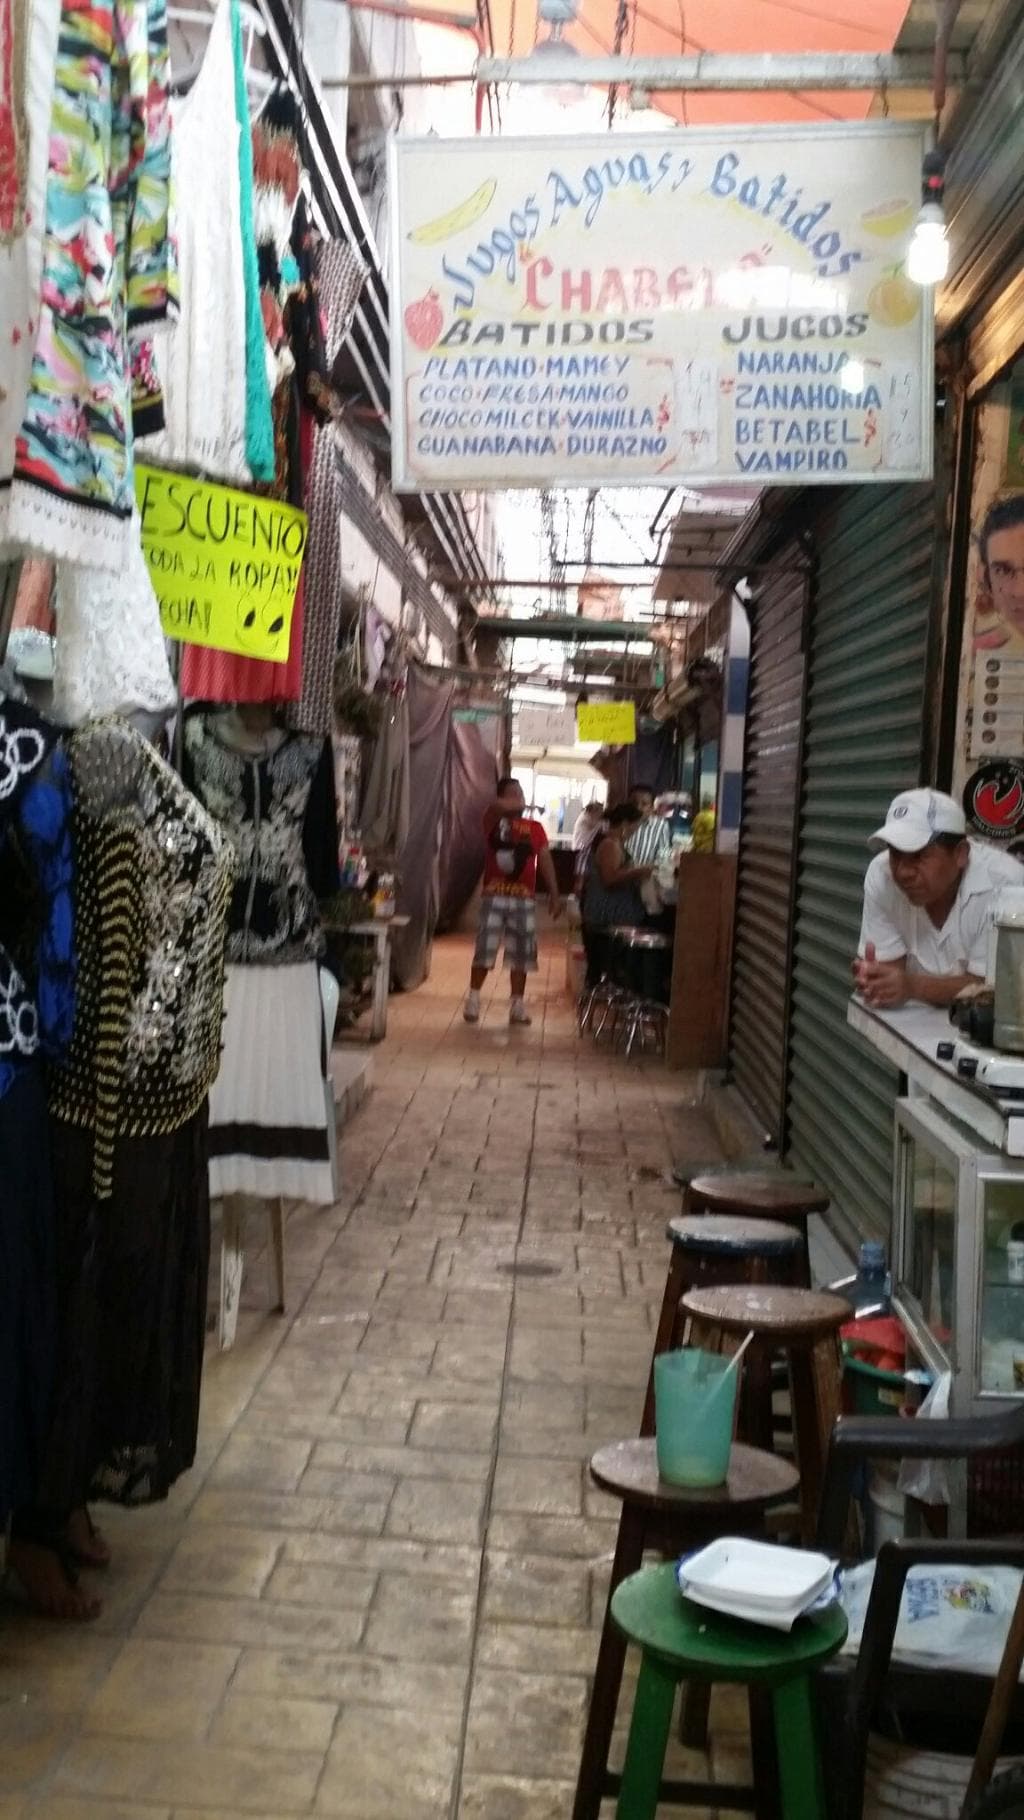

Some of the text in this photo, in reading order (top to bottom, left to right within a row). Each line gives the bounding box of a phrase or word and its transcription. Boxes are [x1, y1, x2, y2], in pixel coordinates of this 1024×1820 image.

[710, 153, 862, 277] Batidos
[438, 318, 654, 347] BATIDOS
[423, 354, 630, 380] PLATANO MAMEY
[419, 382, 630, 404] COCO FRESA MANGO
[566, 407, 654, 430] VAINILLA
[735, 418, 861, 445] BETABEL
[417, 433, 667, 457] GUANABANA DURAZNO
[734, 449, 849, 472] VAMPIRO
